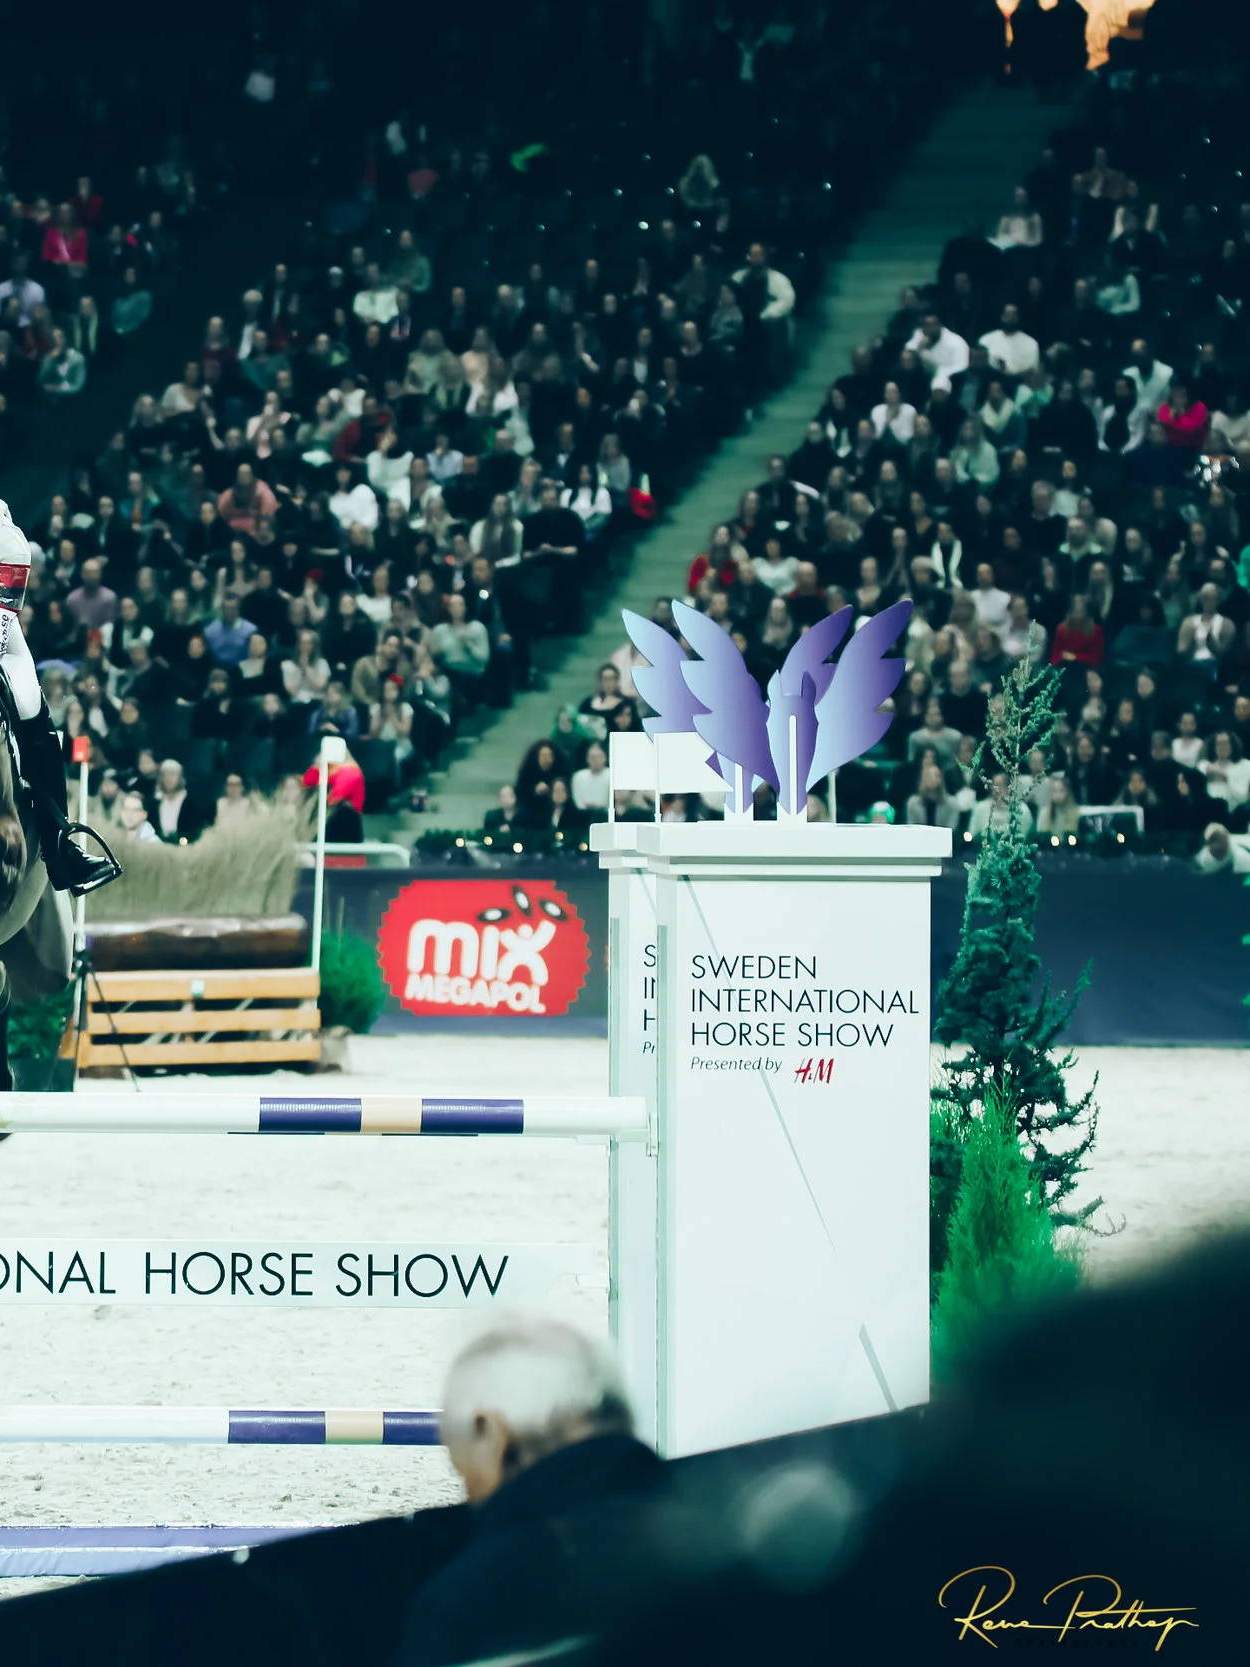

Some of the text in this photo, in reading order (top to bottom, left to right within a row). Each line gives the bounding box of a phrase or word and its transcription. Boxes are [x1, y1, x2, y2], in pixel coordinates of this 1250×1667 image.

[691, 954, 817, 980] SWEDEN
[405, 973, 547, 1013] MEGAPOL
[691, 988, 920, 1014] INTERNATIONAL
[691, 1021, 894, 1048] HORSE SHOW
[690, 1056, 835, 1084] Presented by H&M
[145, 1251, 314, 1297] HORSE
[335, 1252, 510, 1299] SHOW
